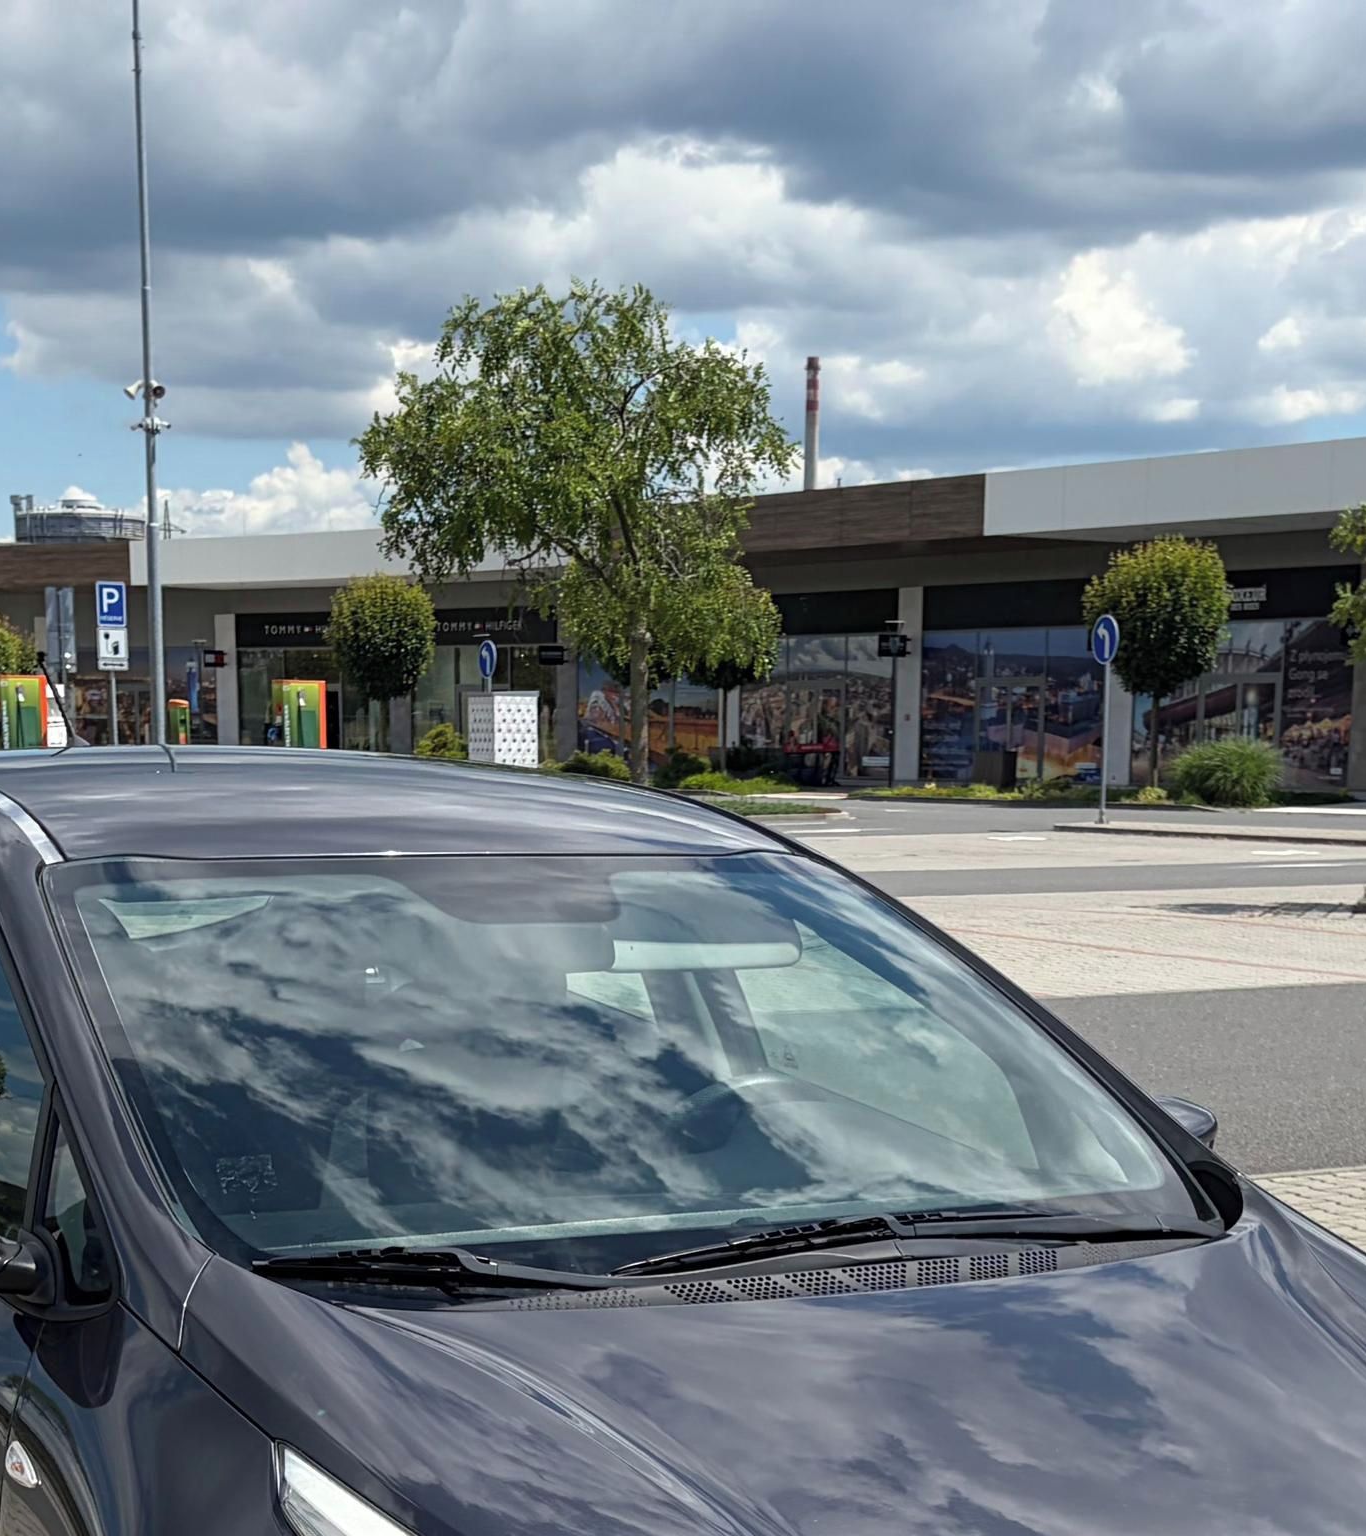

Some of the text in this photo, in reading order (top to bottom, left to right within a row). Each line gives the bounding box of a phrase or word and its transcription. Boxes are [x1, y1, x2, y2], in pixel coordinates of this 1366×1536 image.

[102, 587, 120, 613] P
[264, 625, 302, 635] TOMMY
[436, 621, 473, 632] TOMMY
